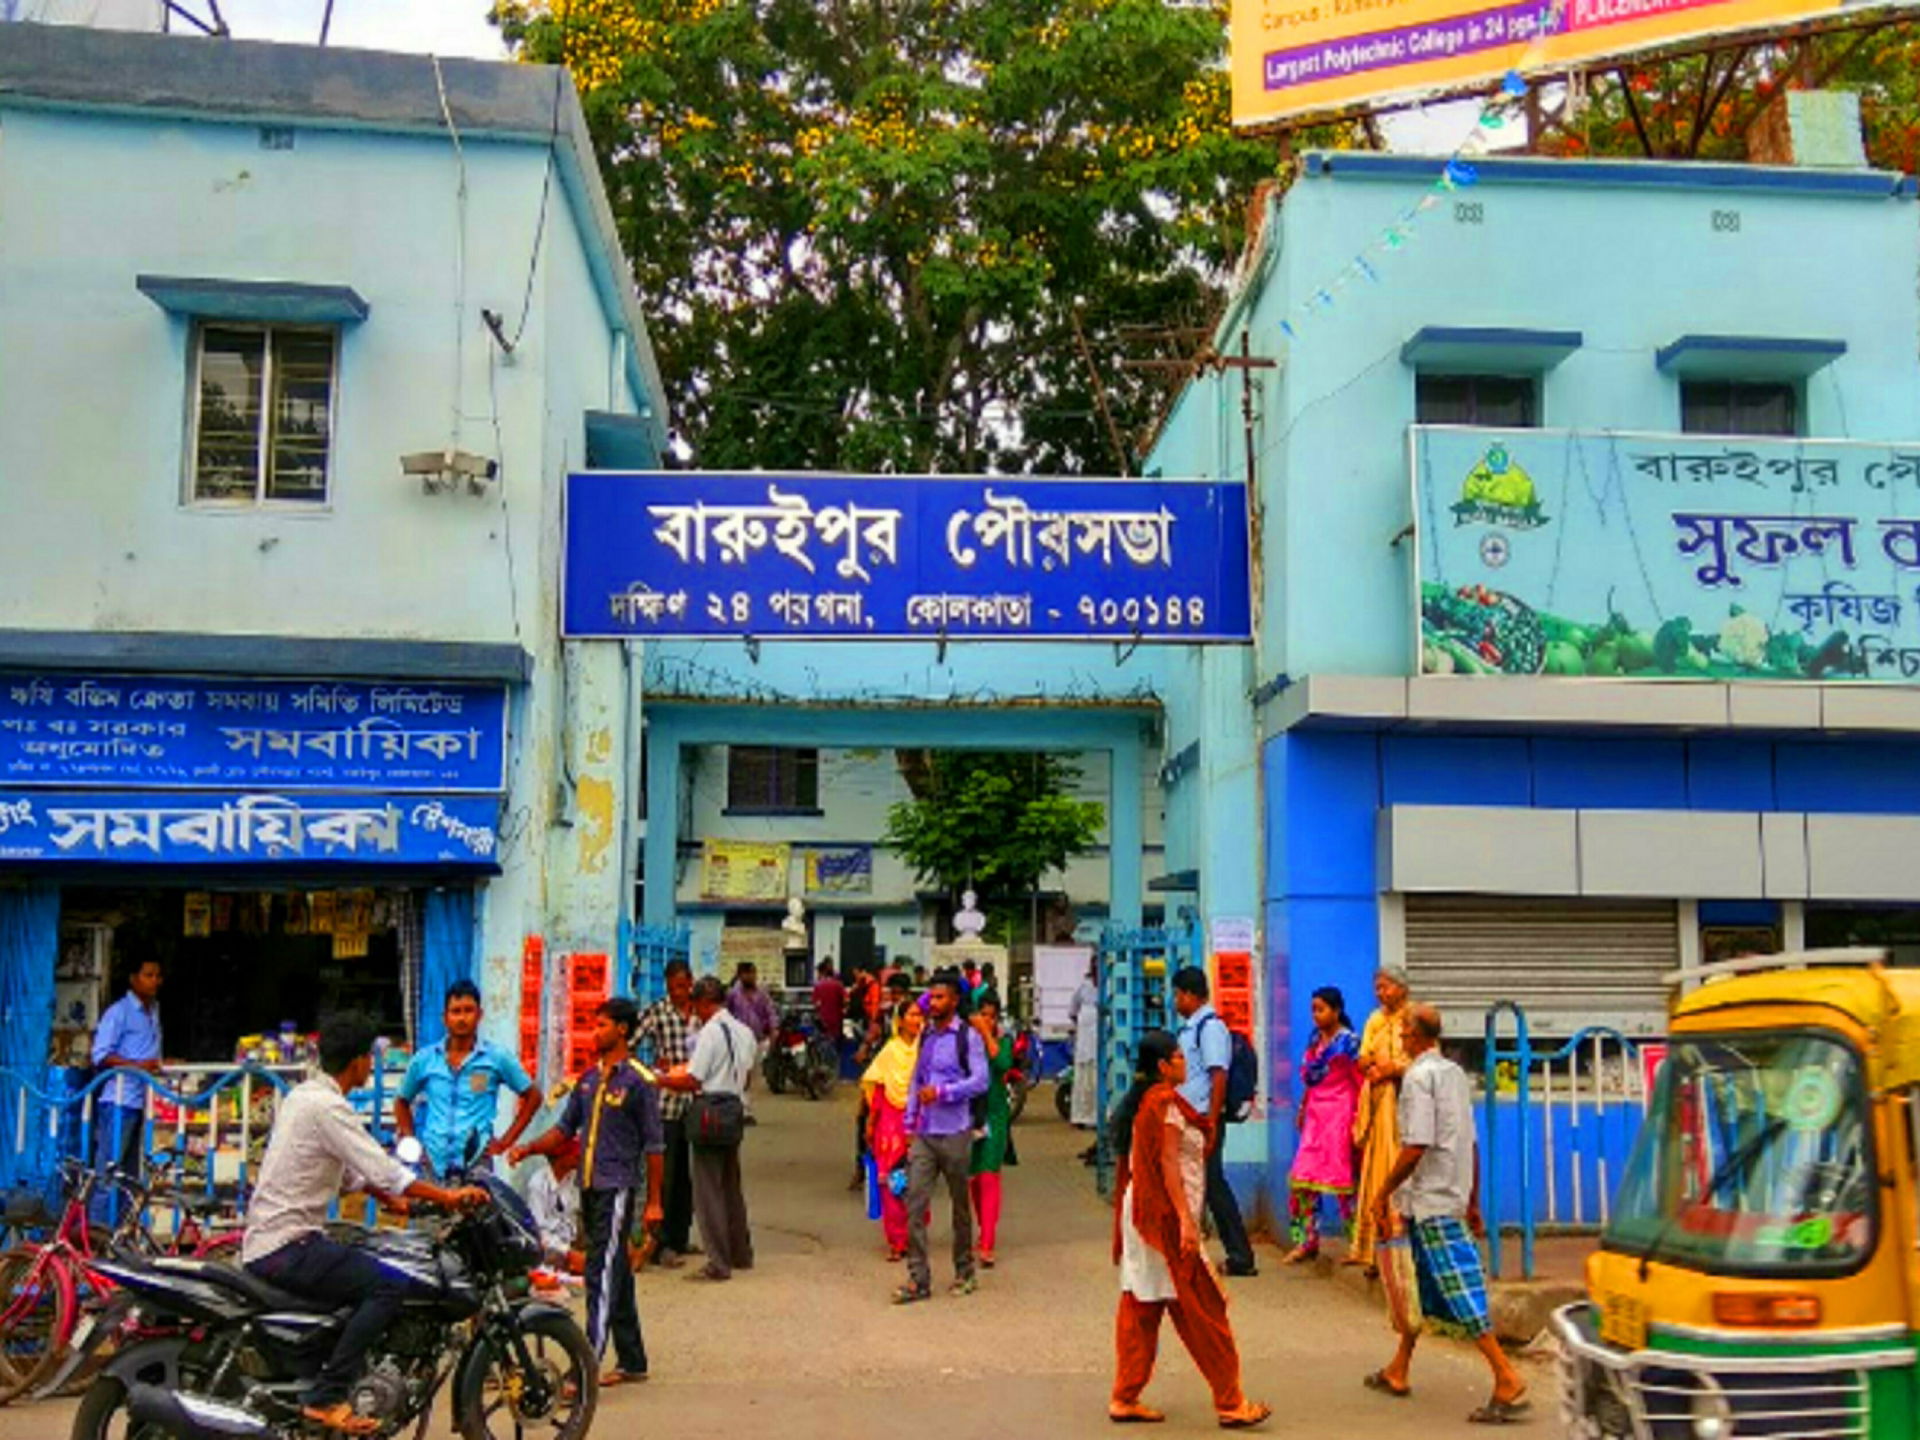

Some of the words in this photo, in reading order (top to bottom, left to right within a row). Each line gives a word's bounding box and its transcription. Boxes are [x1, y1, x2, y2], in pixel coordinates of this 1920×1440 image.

[1266, 53, 1320, 81] Largest
[1324, 35, 1405, 71] Polytechnic
[1408, 28, 1464, 54] College
[1468, 20, 1482, 44] in
[1485, 14, 1504, 41] 24
[1632, 447, 1840, 494] বারুইপুর
[646, 484, 902, 582] বারুইপুর
[946, 487, 1175, 571] পৌরসভা
[1672, 513, 1858, 586] সুফল
[609, 581, 687, 625] দক্ষিণ
[707, 591, 751, 624] ২৪
[769, 589, 875, 629] পরগনা,
[906, 592, 1033, 626] কোলকাতা
[1078, 594, 1205, 626] ৭০০১৪৪
[1784, 580, 1902, 634] কৃষিজ
[206, 690, 280, 712] সমবায়
[290, 685, 361, 713] সমিতি
[370, 687, 464, 713] লিমিটেড
[20, 738, 165, 760] অনুমোদিত
[88, 719, 187, 738] সরকার
[218, 716, 483, 761] সমবায়িকা
